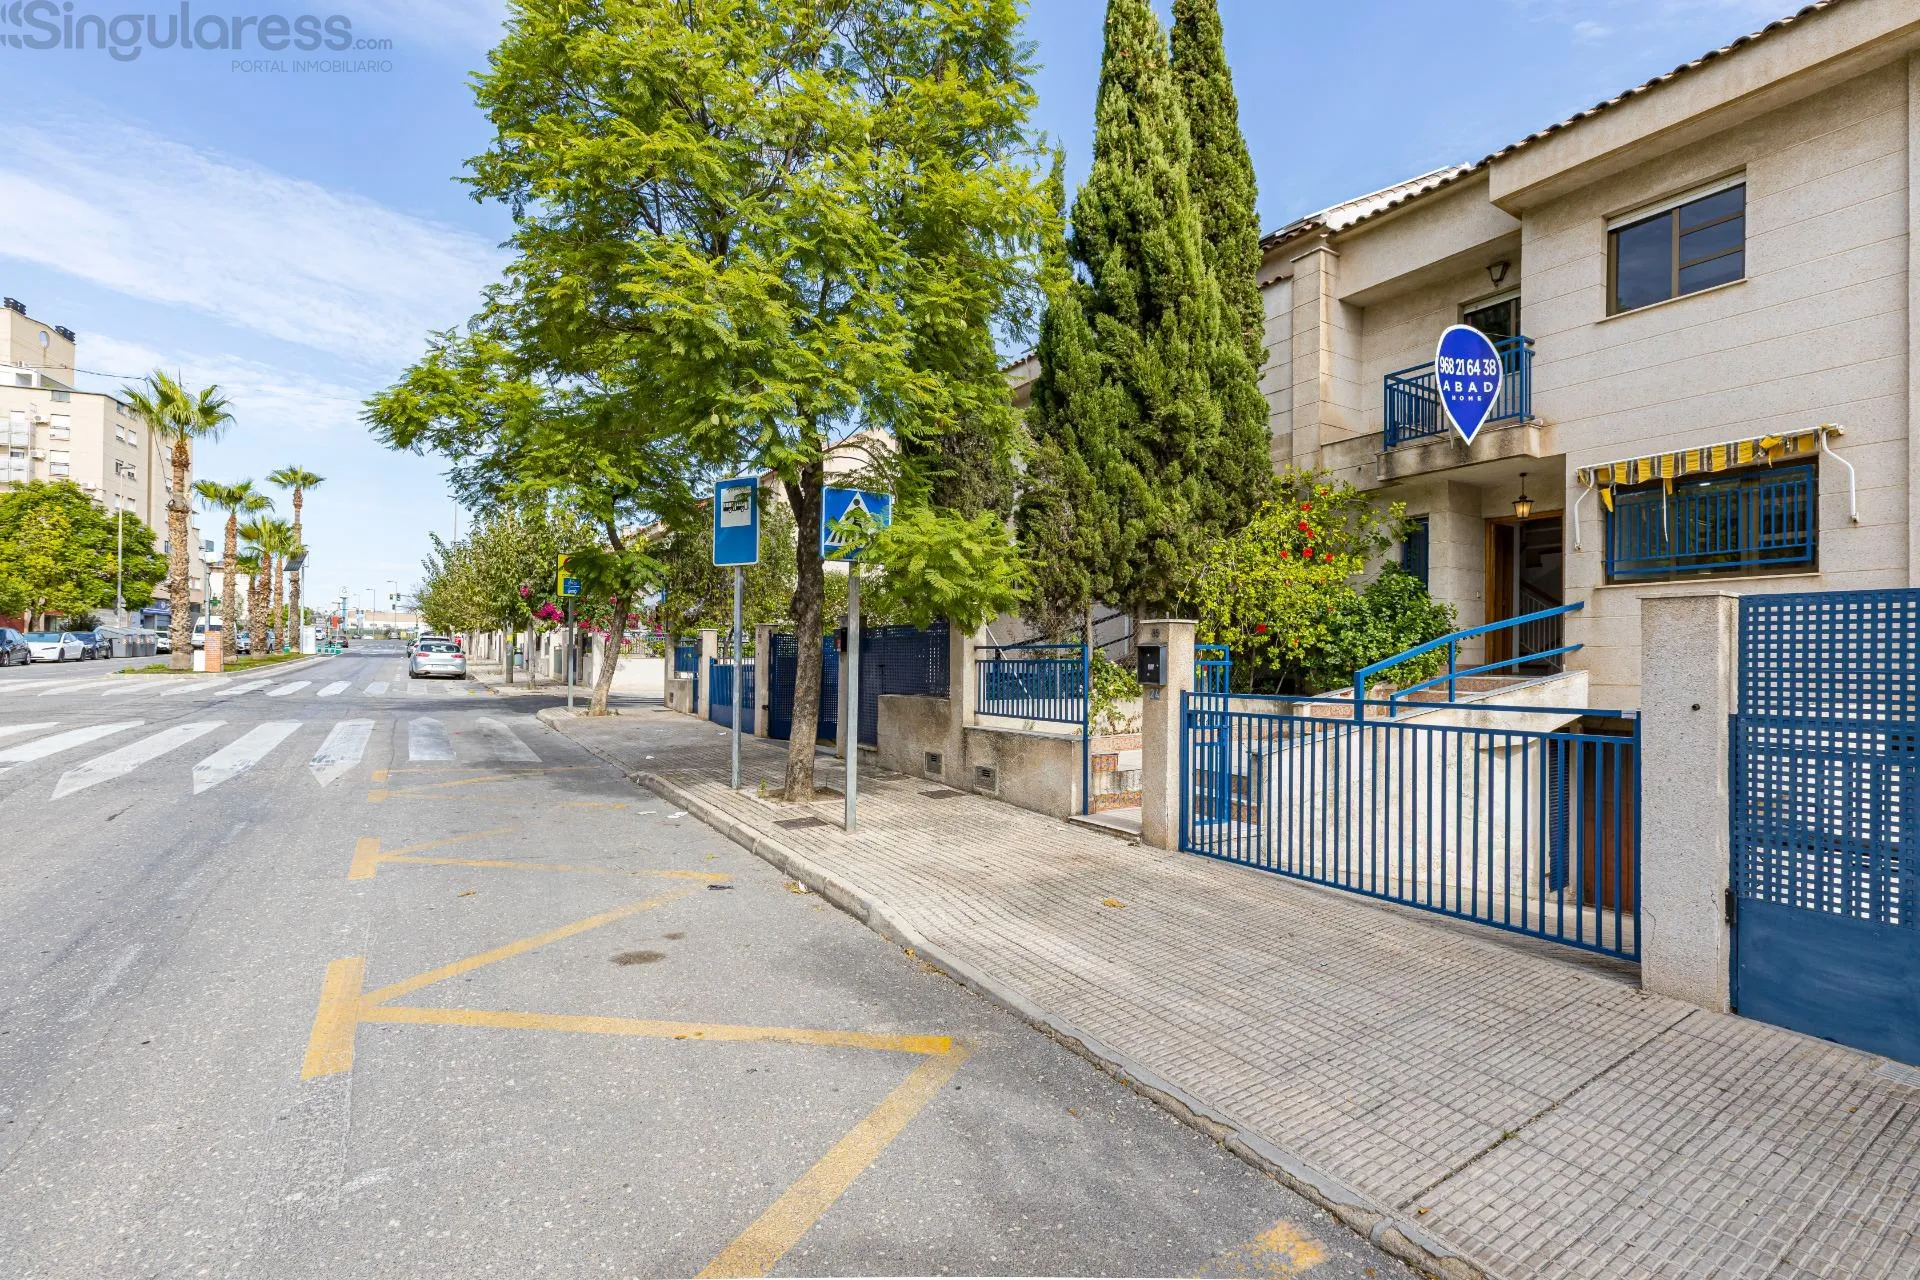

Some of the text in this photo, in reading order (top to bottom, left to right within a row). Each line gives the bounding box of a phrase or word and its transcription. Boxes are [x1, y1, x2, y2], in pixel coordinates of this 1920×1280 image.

[1440, 356, 1497, 376] 968 21 64 38
[1443, 380, 1493, 393] ABAD
